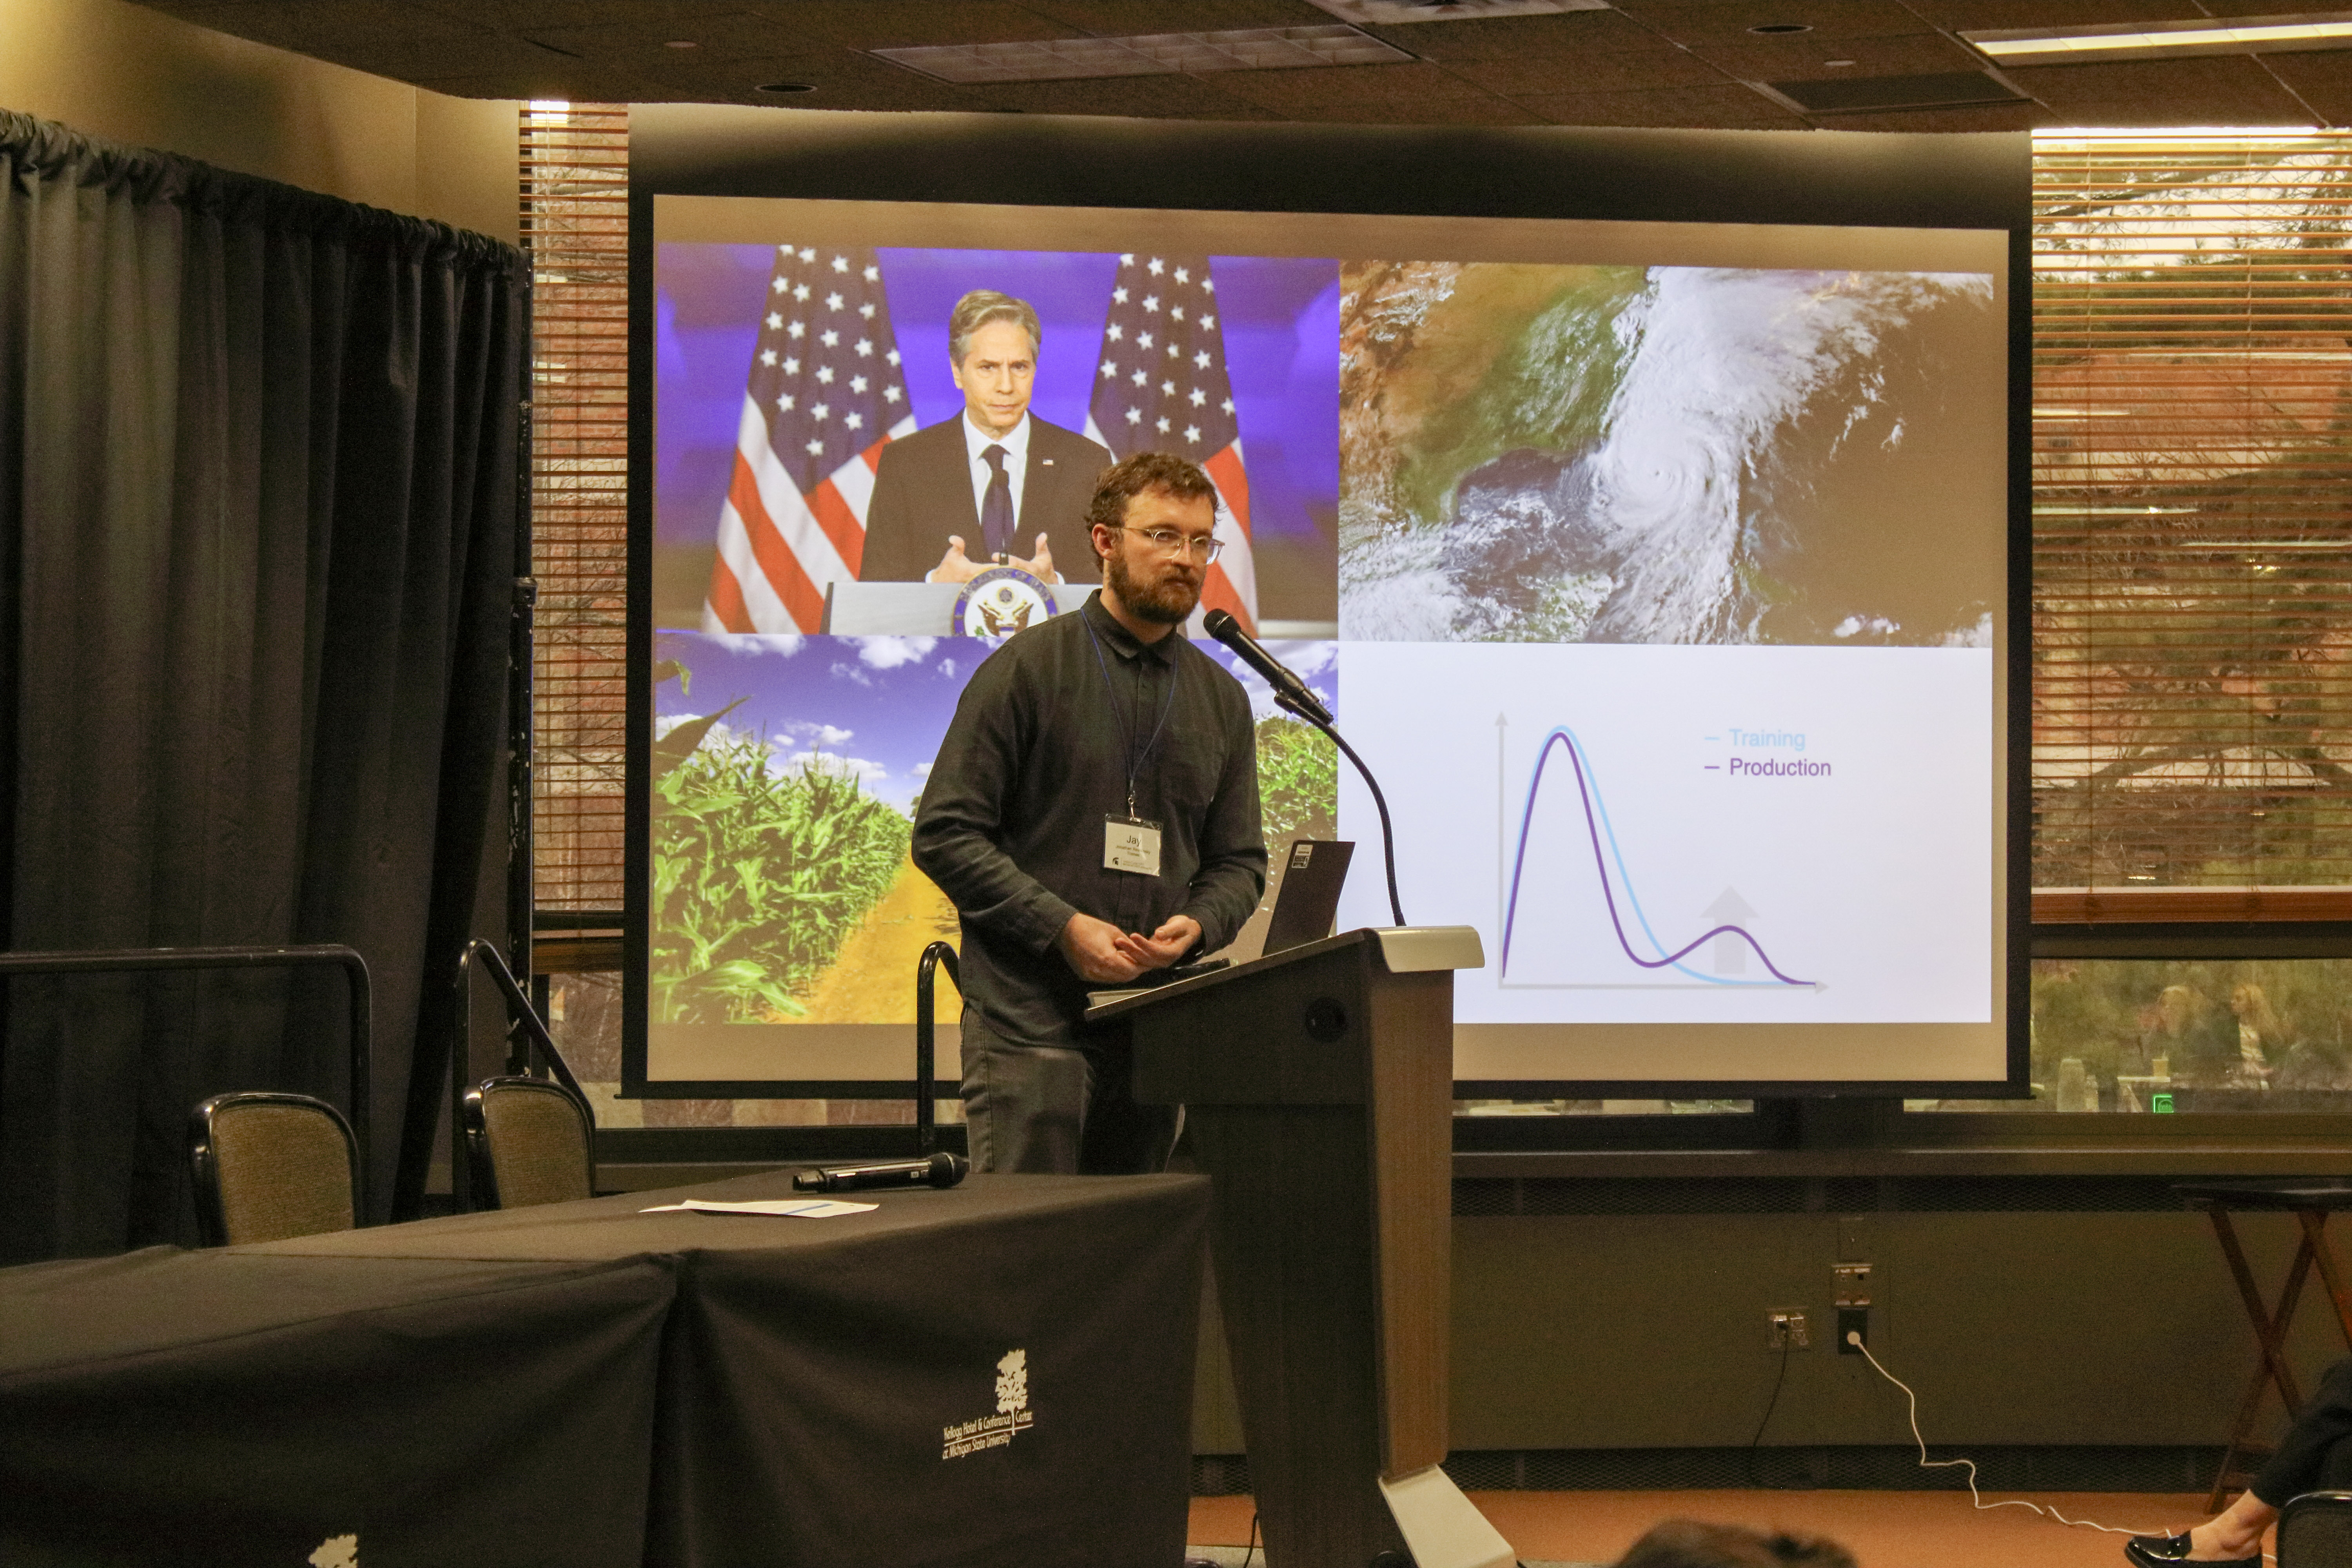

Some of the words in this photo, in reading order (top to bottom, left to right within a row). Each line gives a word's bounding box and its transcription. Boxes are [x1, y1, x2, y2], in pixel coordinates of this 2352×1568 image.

[1729, 729, 1806, 751] Training
[1730, 758, 1831, 776] Production
[1127, 835, 1141, 847] Jay
[944, 1426, 962, 1441] Kellogg
[963, 1420, 977, 1435] Hotel
[978, 1418, 983, 1431] &
[983, 1415, 1011, 1430] Conference
[1015, 1410, 1033, 1423] Center
[942, 1450, 949, 1460] at
[949, 1443, 971, 1458] Michigan
[972, 1439, 986, 1451] State
[986, 1432, 1011, 1447] University
